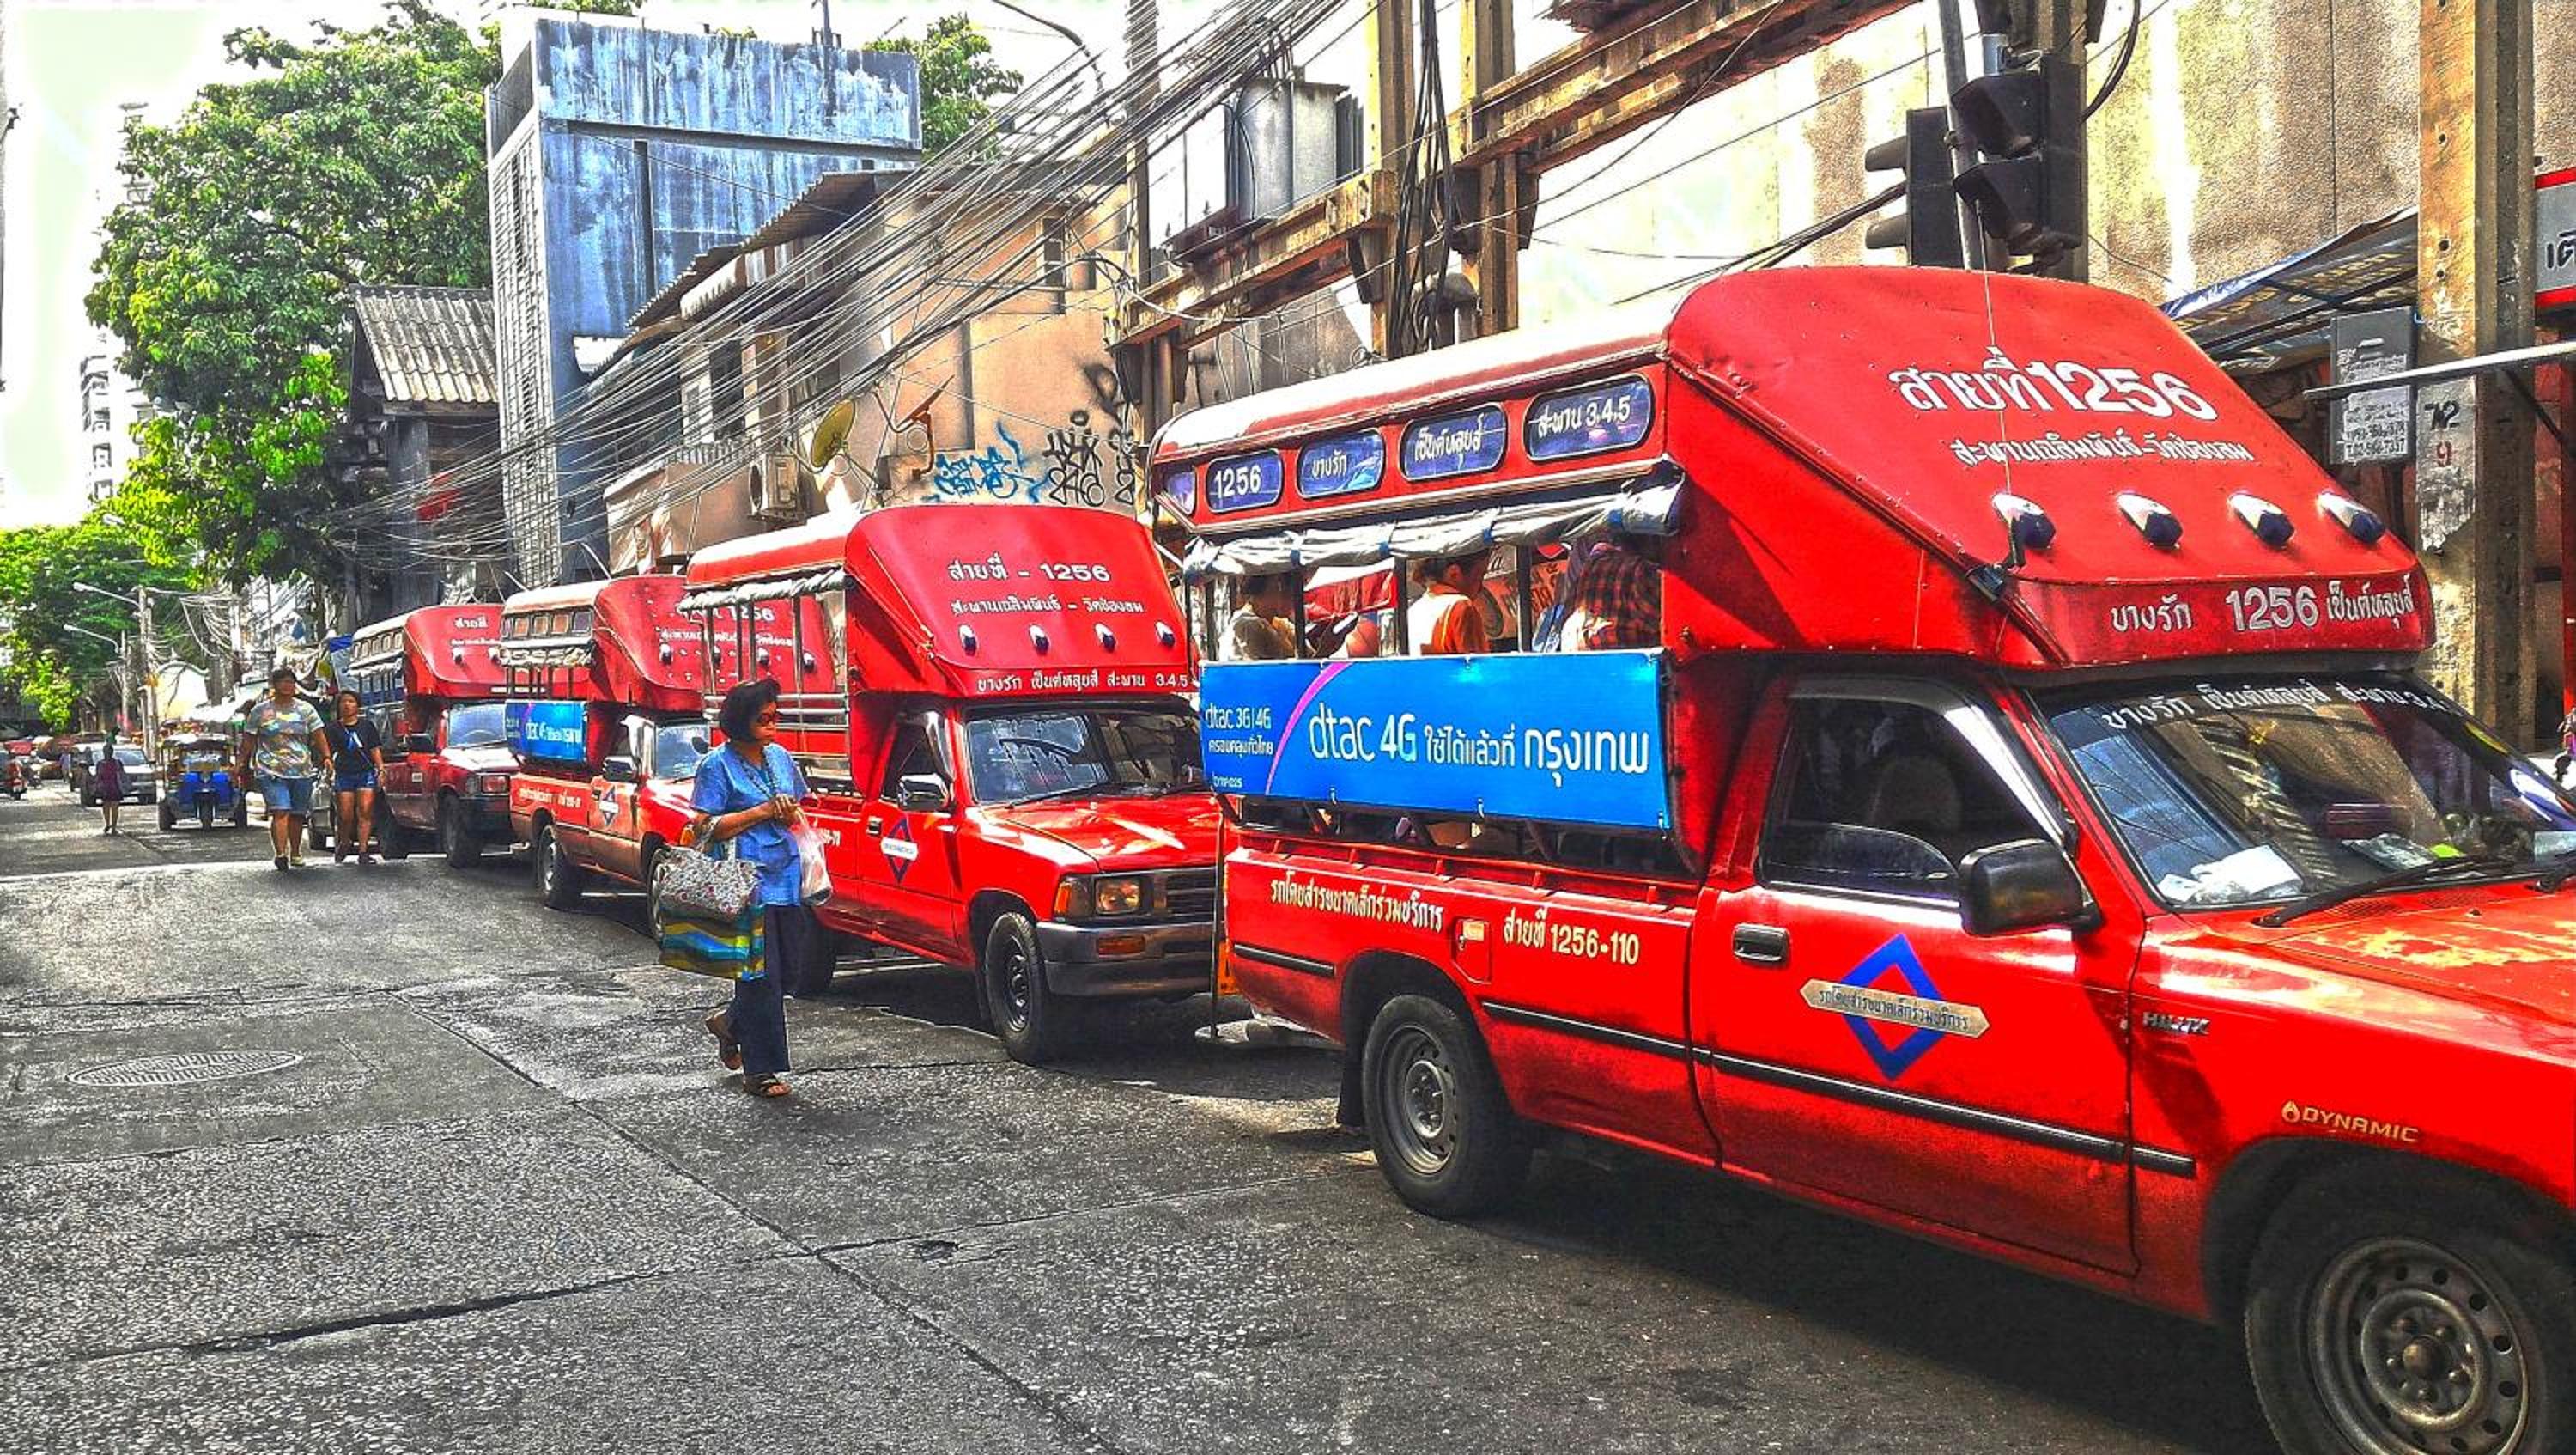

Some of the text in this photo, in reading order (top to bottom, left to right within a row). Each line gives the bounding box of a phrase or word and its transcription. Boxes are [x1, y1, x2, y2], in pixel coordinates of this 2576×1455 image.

[1538, 406, 1583, 438] สะพาน
[1215, 465, 1261, 498] 1256
[1311, 450, 1347, 481] บางรัก
[948, 552, 1008, 581] สายที่
[1040, 563, 1111, 581] 1256
[2111, 594, 2192, 632] บางรัก
[2226, 584, 2318, 631] 1256
[977, 674, 1023, 692] บางรัก
[1107, 670, 1145, 687] สะพาน
[1205, 703, 1233, 729] dtac
[2102, 694, 2195, 729] บางรัก
[1309, 703, 1649, 788] dtac 4G ใช้ได้แล้วที่ กรุงเทพ
[1504, 906, 1639, 965] สายที่ 1256-110
[2302, 1106, 2419, 1143] DYNAMIC
